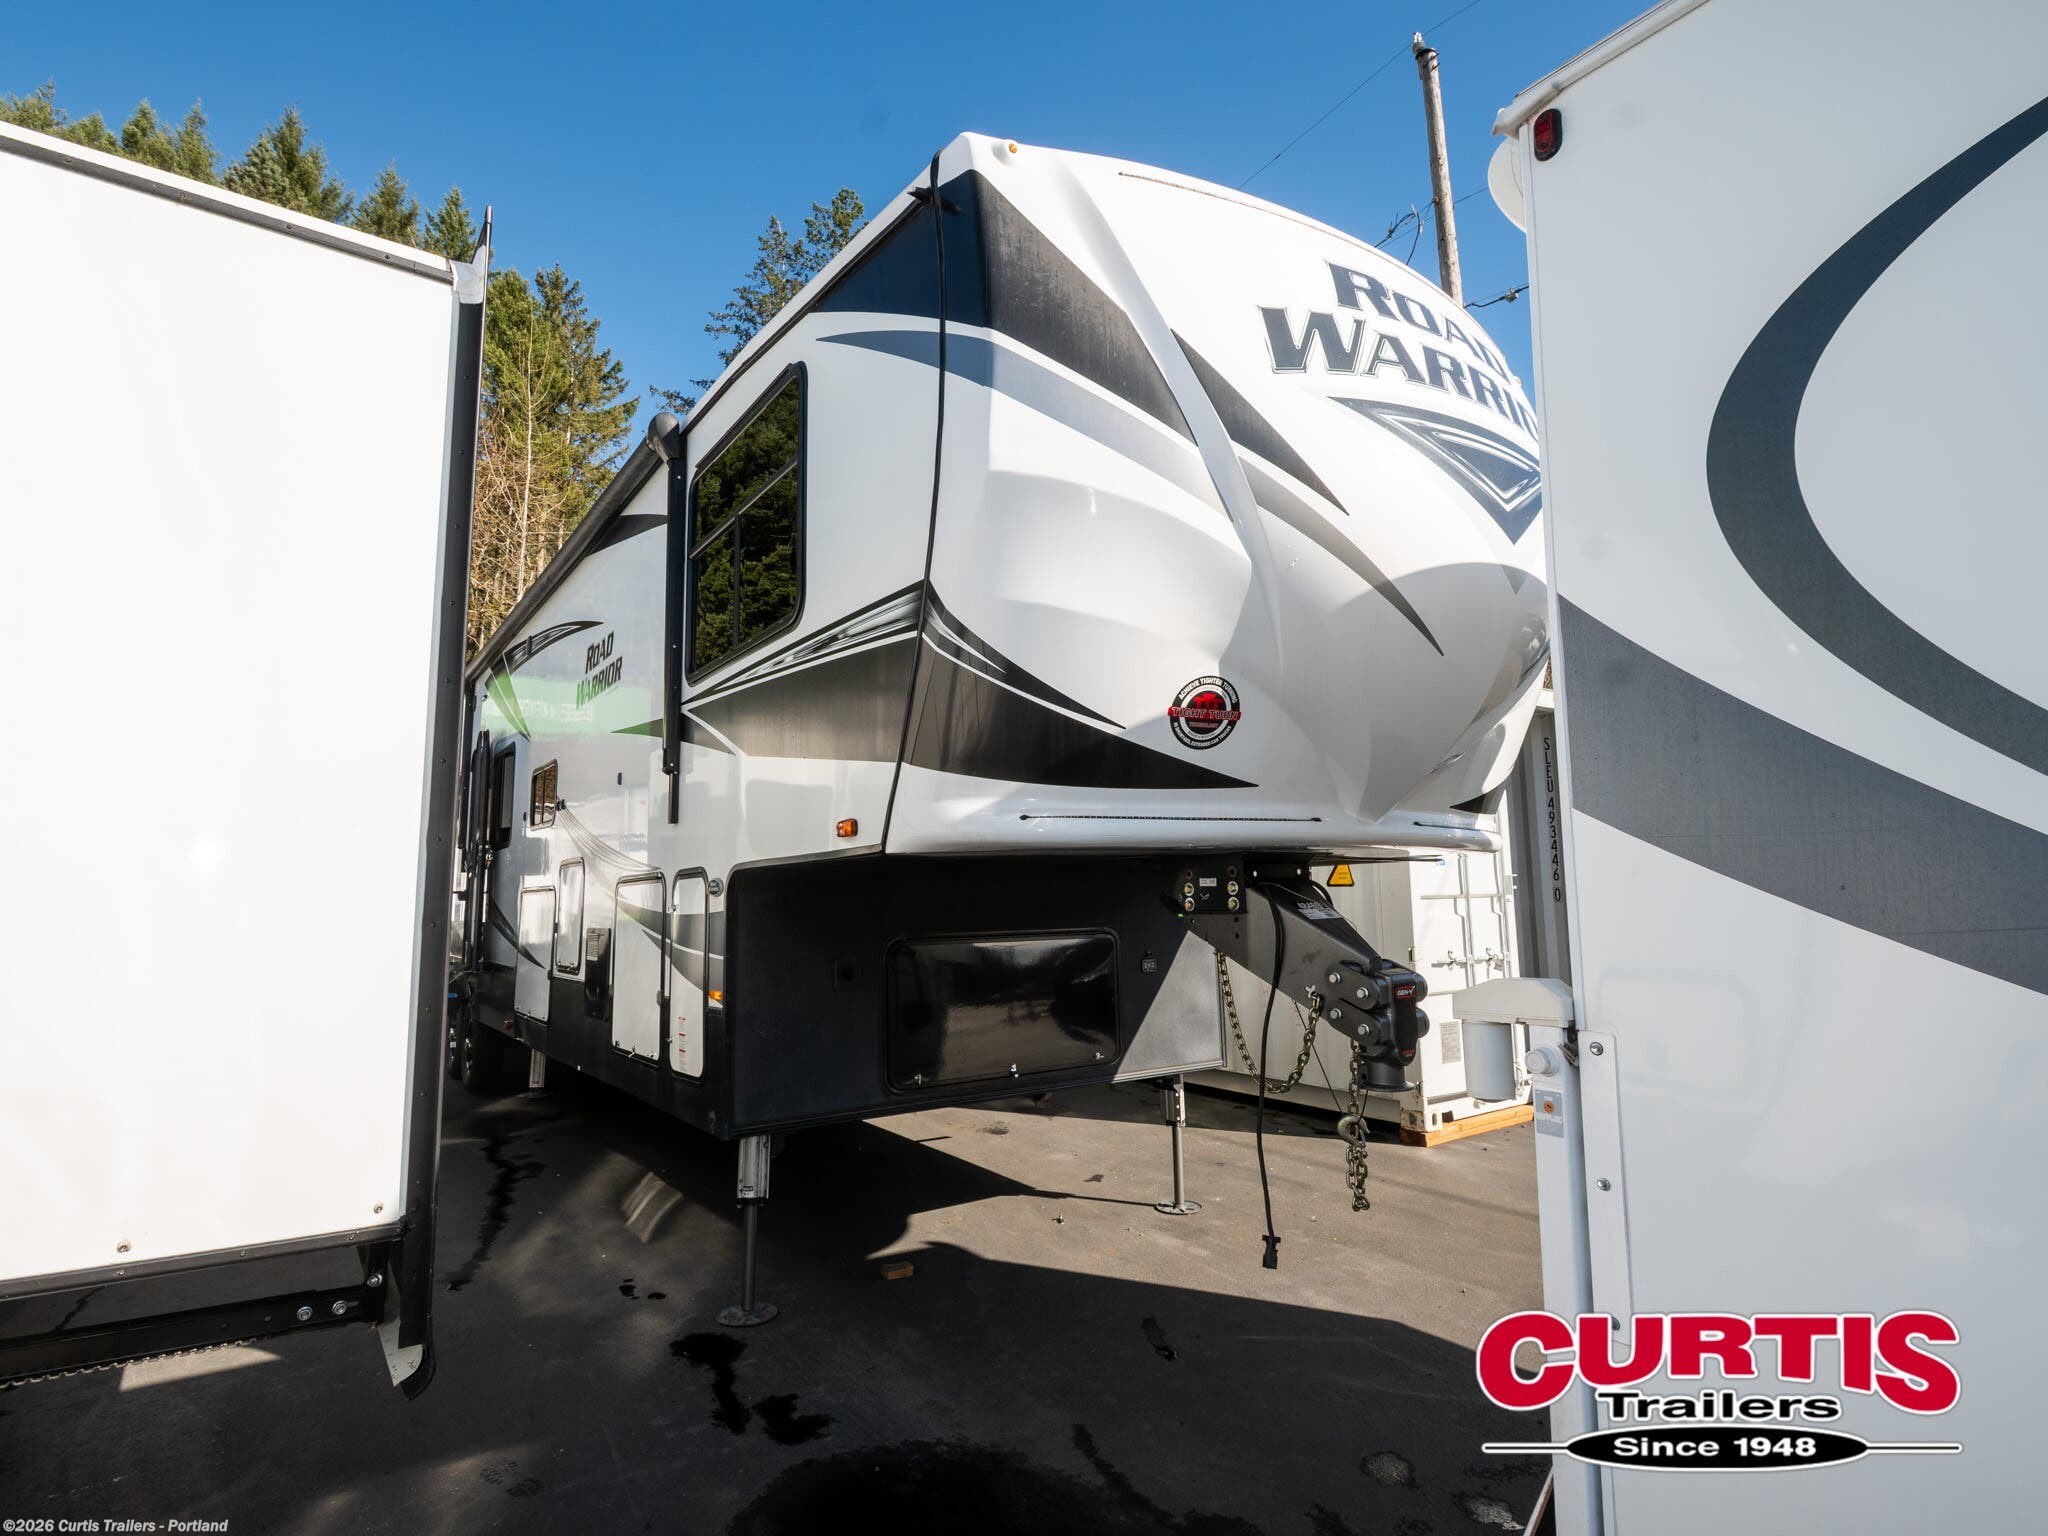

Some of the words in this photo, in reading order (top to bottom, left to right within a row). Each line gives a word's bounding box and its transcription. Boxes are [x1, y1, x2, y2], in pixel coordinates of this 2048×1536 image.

[1323, 259, 1512, 386] ROAD
[1257, 304, 1540, 444] WARRIO
[585, 630, 614, 675] ROAD
[576, 655, 623, 710] WARRIOR
[1178, 680, 1200, 700] ACHIEVE
[1199, 677, 1223, 686] TIGHTER
[1172, 707, 1207, 718] TIGHT
[1208, 709, 1239, 721] TURN
[1543, 737, 1554, 793] SLEU
[1547, 797, 1560, 881] 493446
